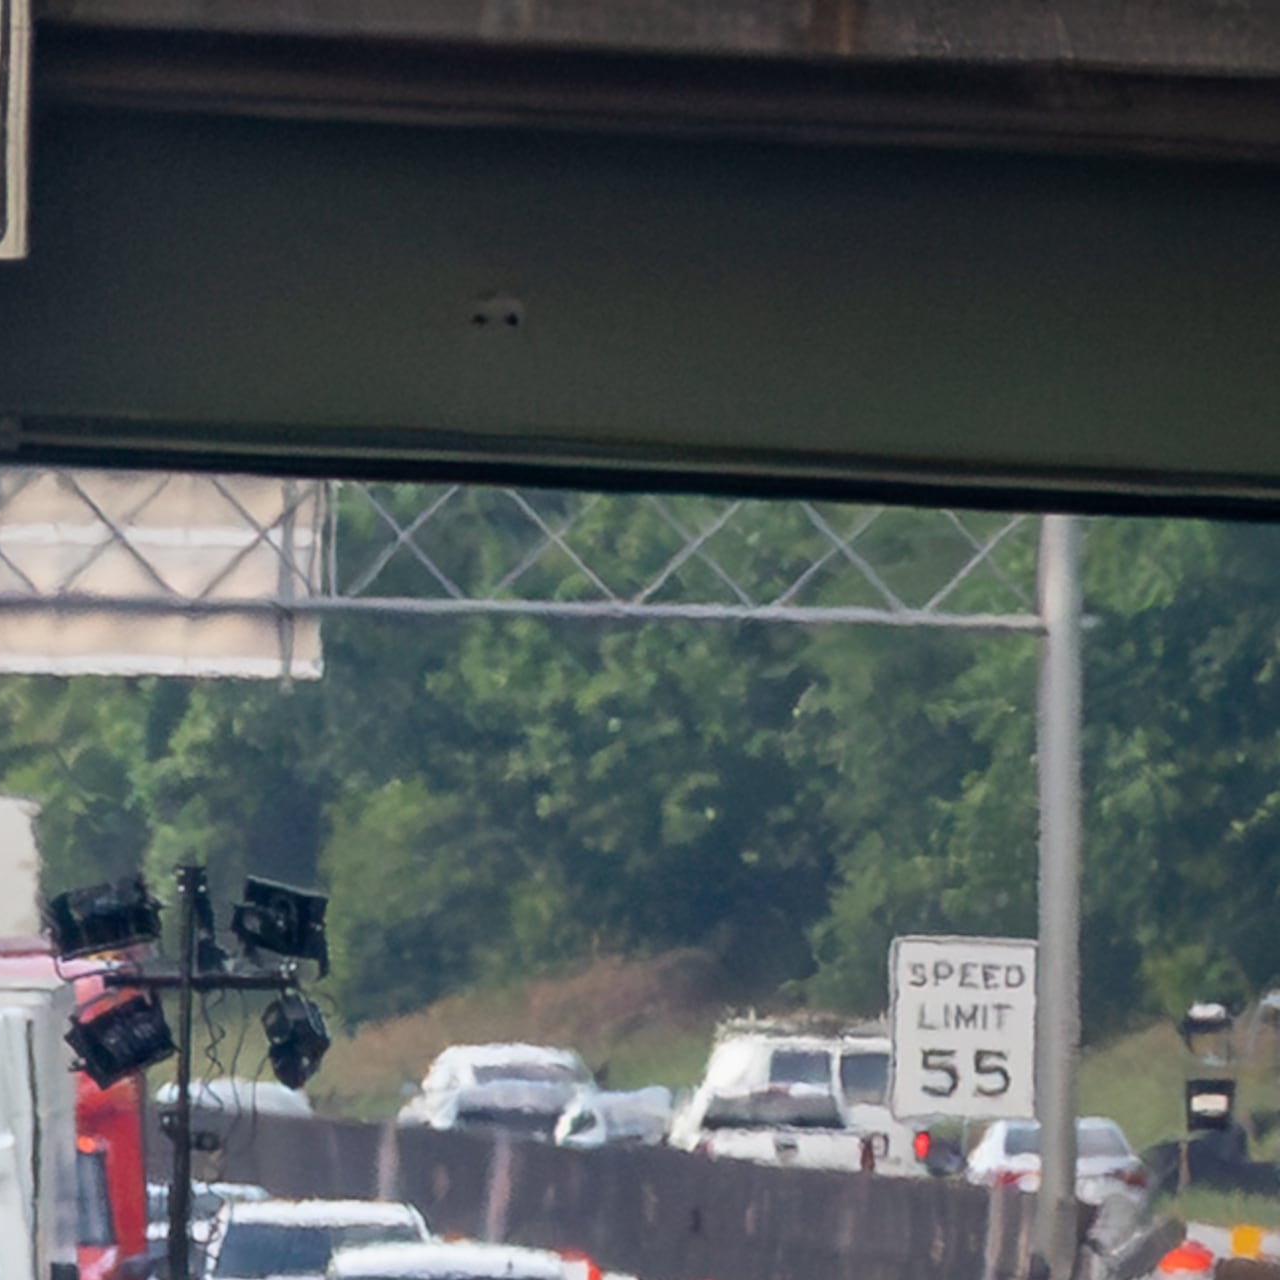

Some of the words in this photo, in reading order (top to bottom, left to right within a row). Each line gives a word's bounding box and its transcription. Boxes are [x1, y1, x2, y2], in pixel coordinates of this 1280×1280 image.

[907, 959, 1027, 990] SPEED
[917, 1003, 1013, 1031] LIMIT
[920, 1048, 1011, 1098] 55
